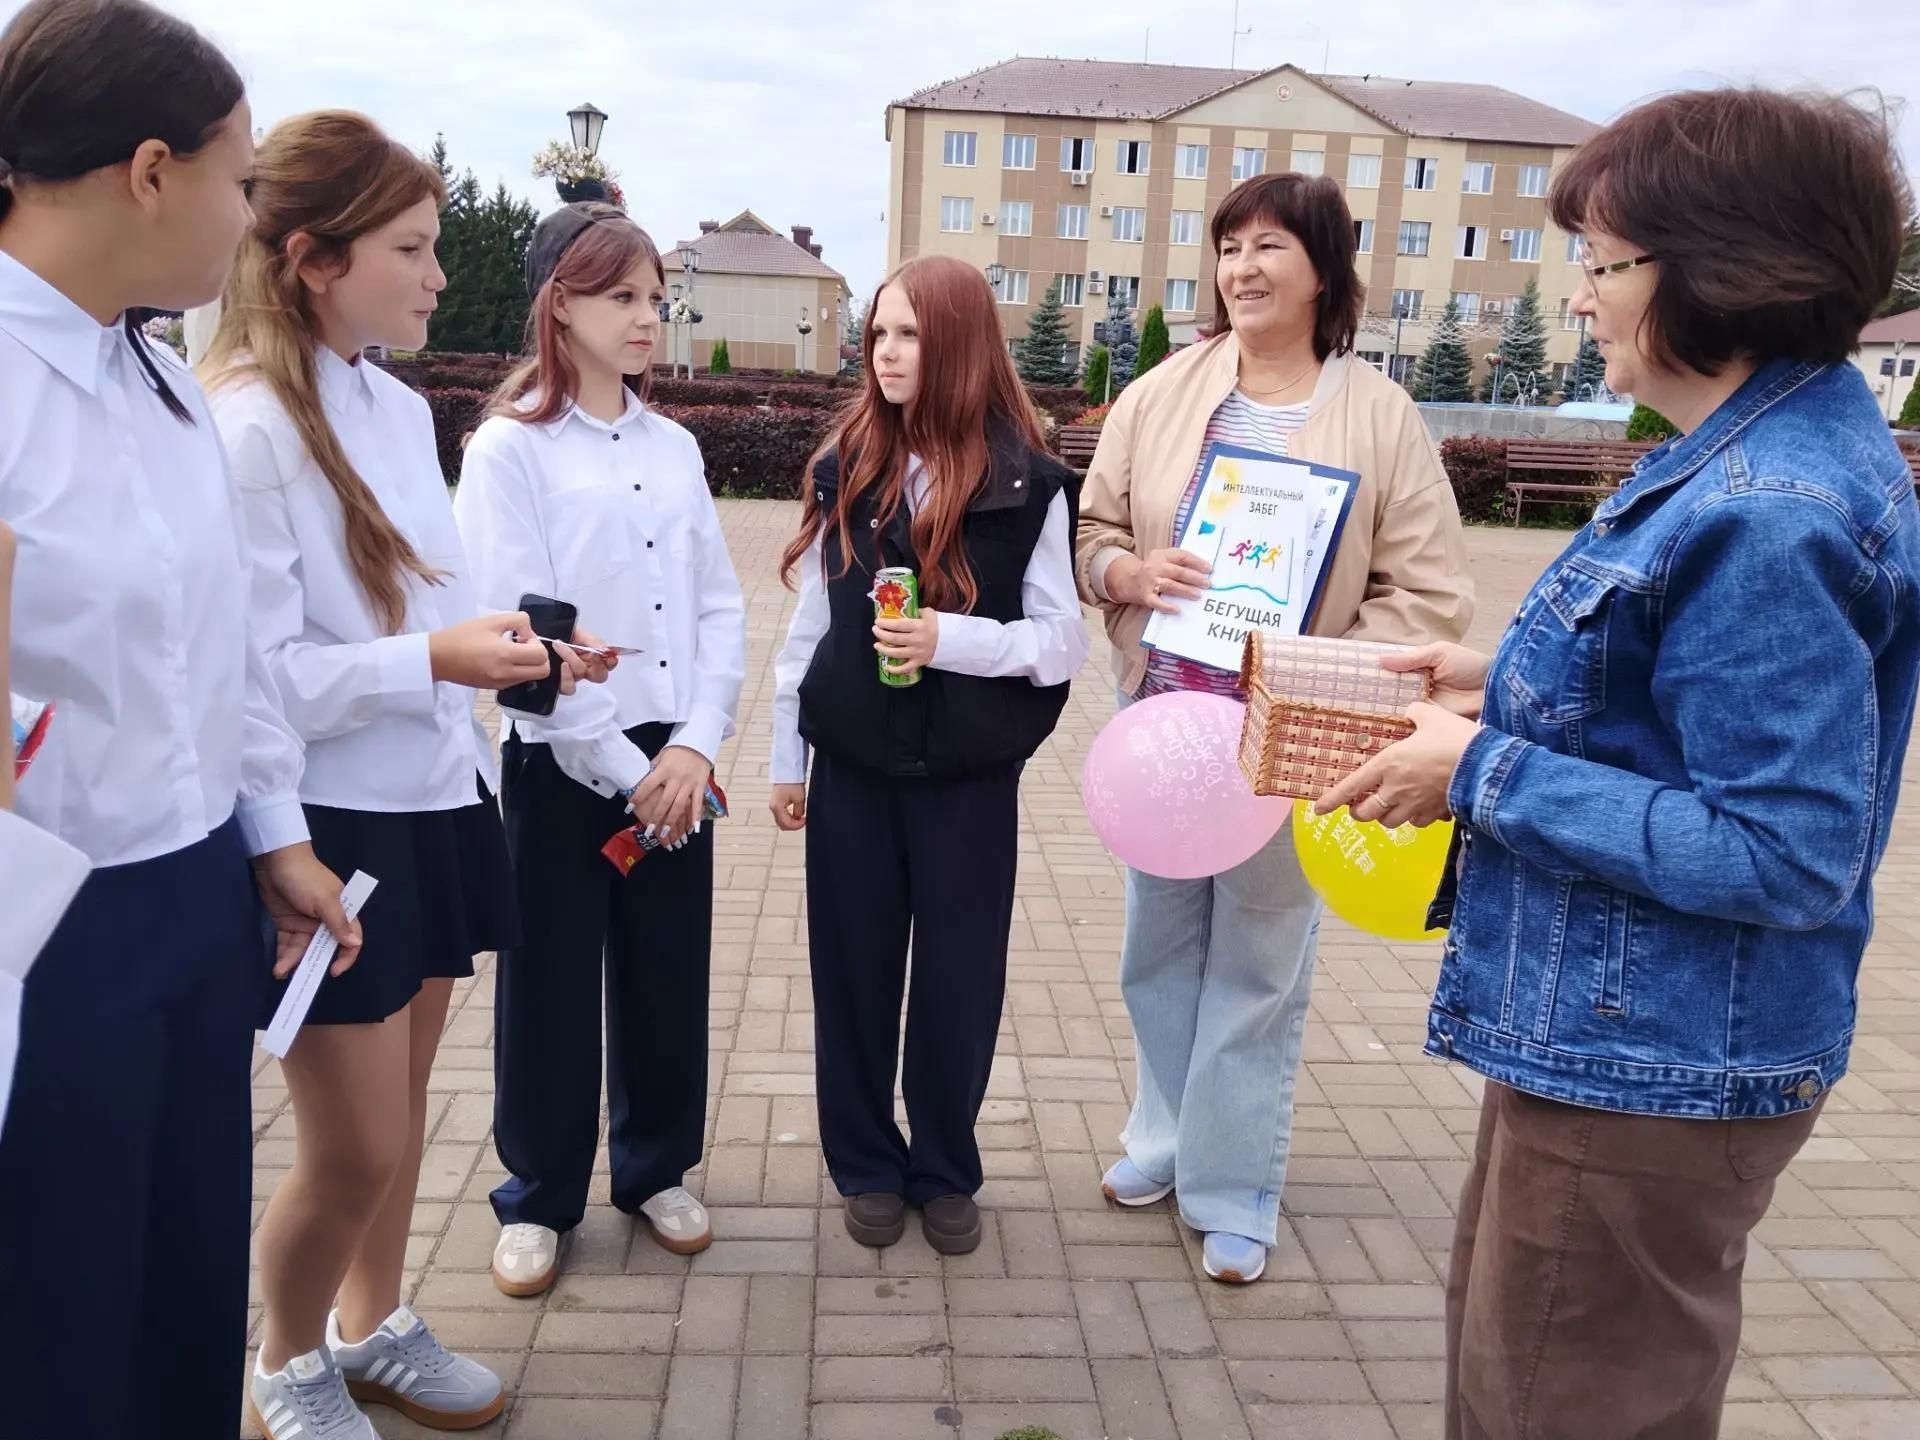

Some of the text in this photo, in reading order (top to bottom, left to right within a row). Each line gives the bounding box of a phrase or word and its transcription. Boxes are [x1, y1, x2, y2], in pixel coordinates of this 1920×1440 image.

[1223, 482, 1304, 502] ИНТЕЛЛЕКТУАЛЬНЫЙ
[1249, 501, 1278, 516] ЗАБЕГ
[1204, 599, 1281, 628] БЕГУЩАЯ
[1207, 622, 1248, 645] КНИ
